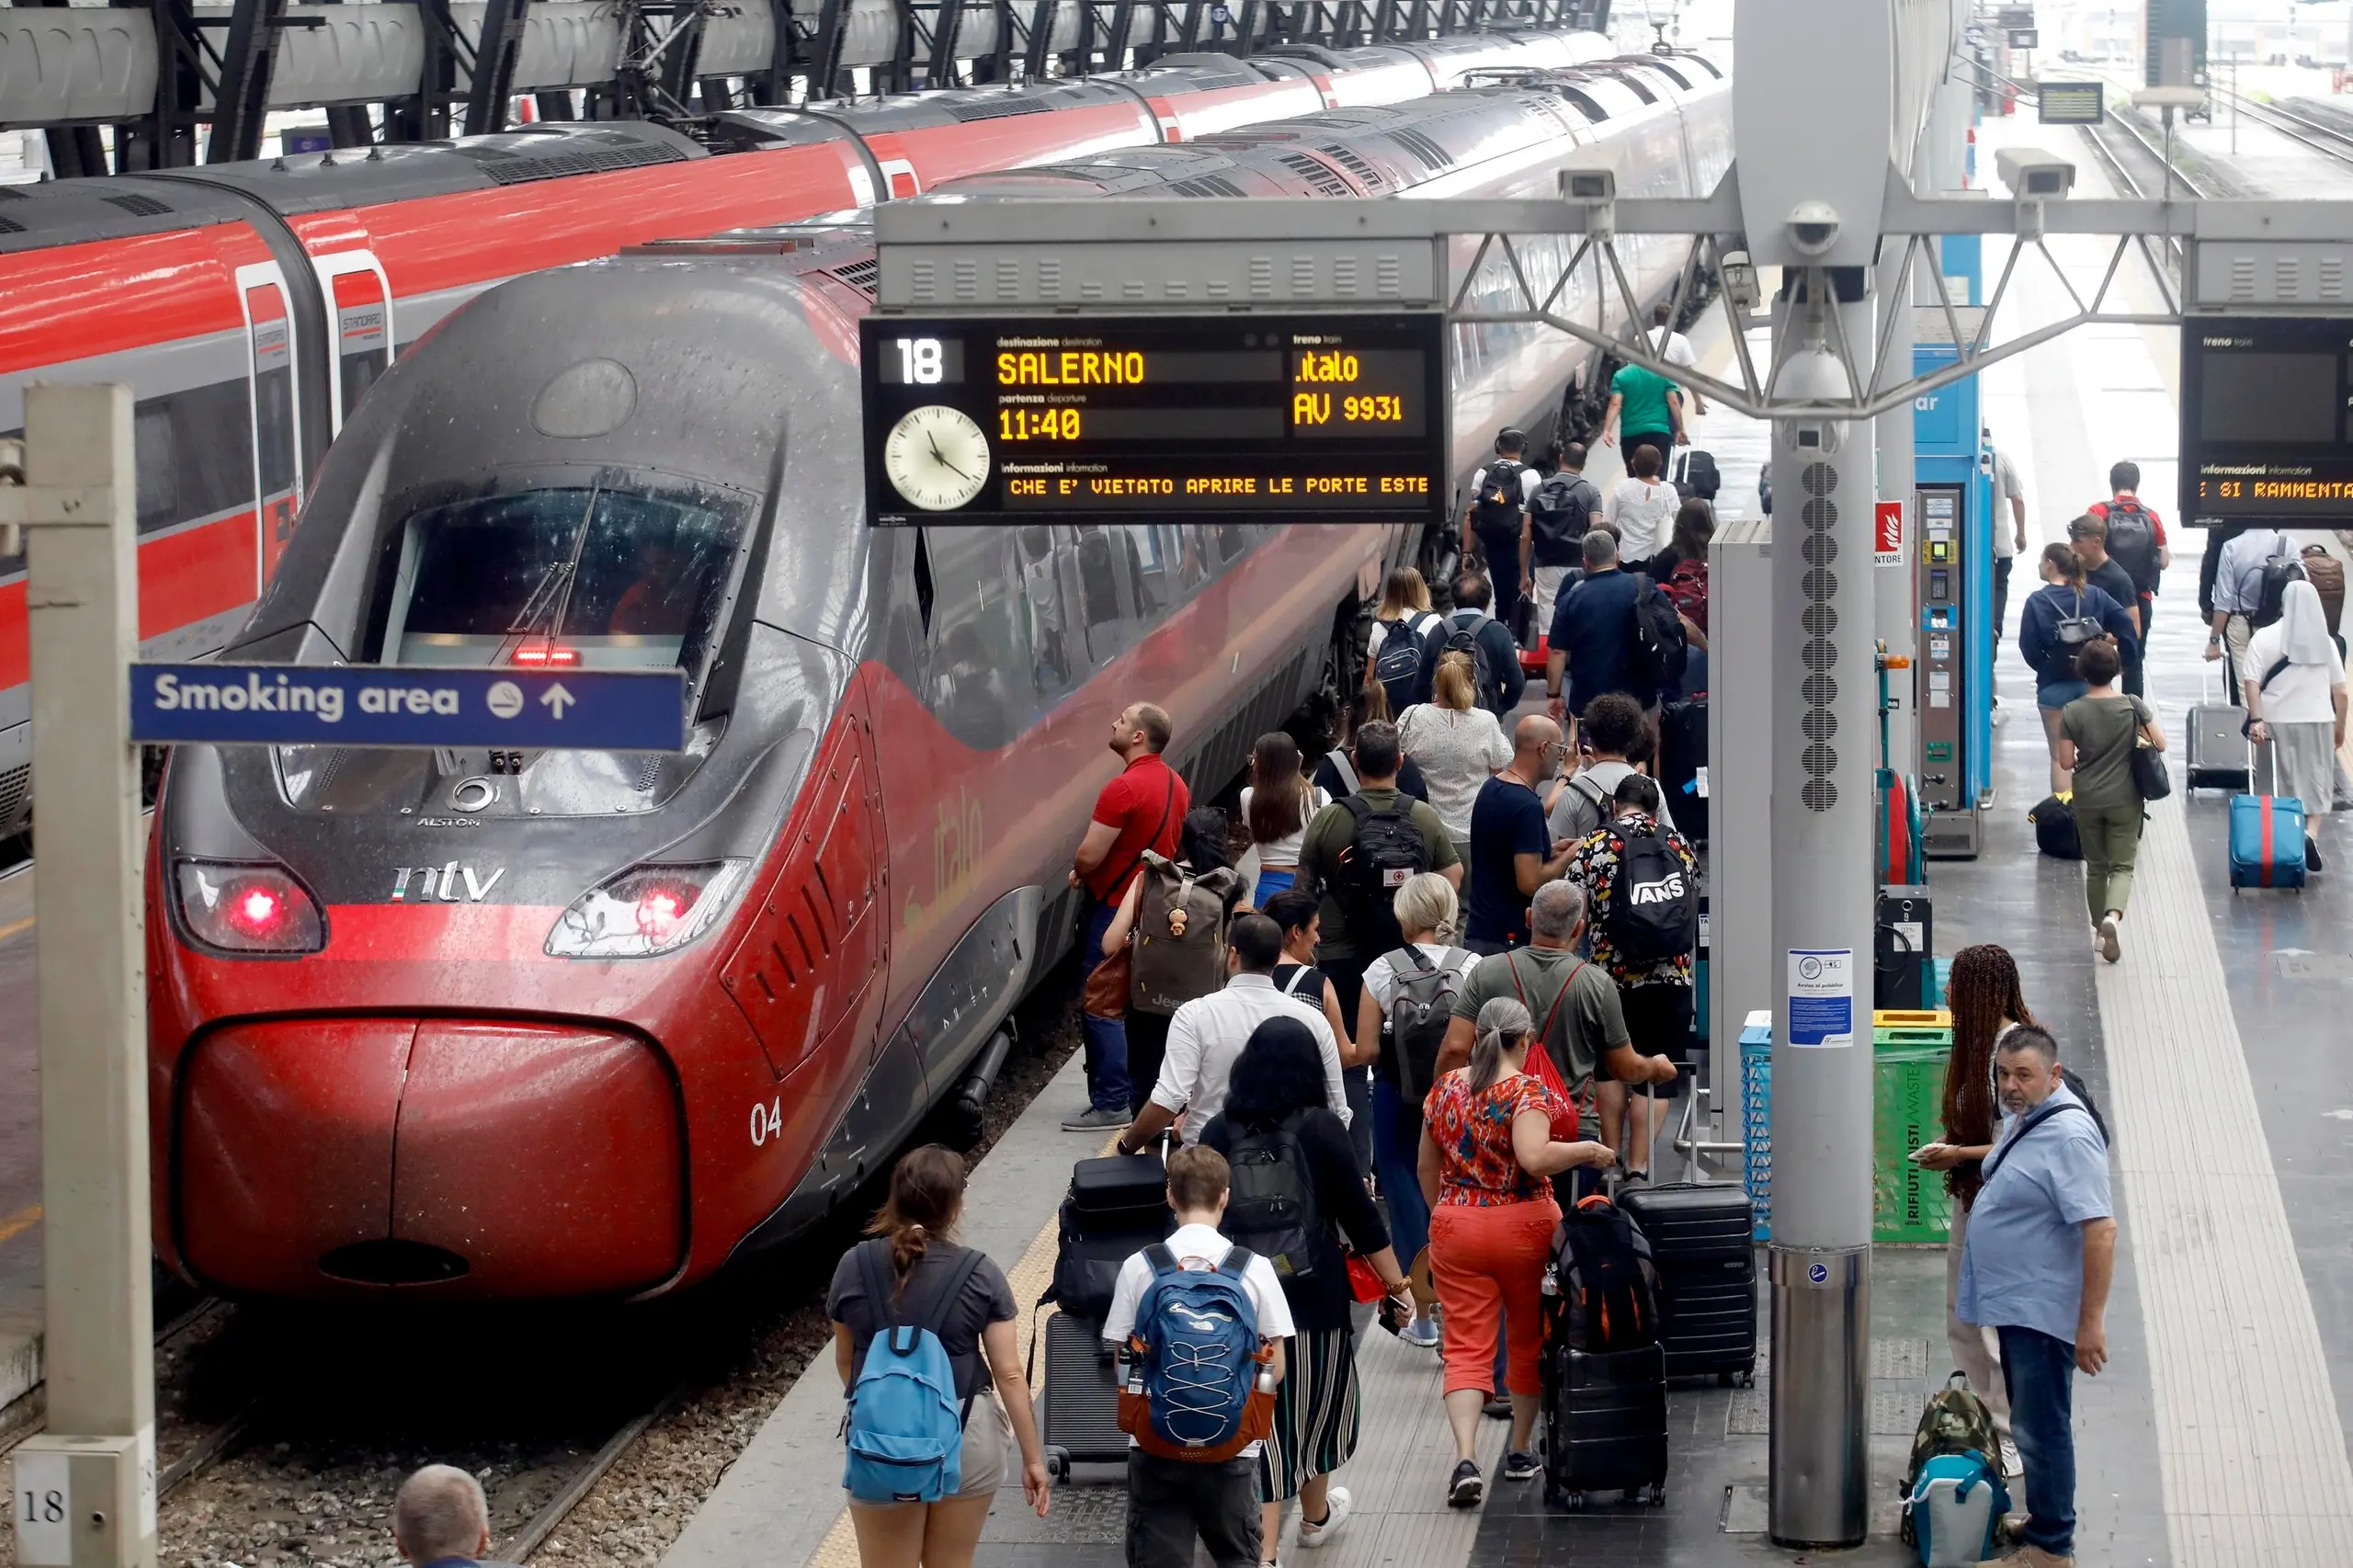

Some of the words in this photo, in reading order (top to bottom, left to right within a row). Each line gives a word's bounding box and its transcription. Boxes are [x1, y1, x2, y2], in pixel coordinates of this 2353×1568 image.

[343, 312, 381, 330] STANDARD
[996, 336, 1060, 347] destinazione
[1062, 337, 1102, 347] destination
[1293, 335, 1322, 345] treno
[1324, 335, 1342, 344] train
[2203, 335, 2232, 347] treno
[2234, 337, 2254, 347] train
[897, 338, 942, 383] 18
[997, 352, 1144, 384] SALERNO
[998, 393, 1045, 405] partenza
[1047, 392, 1086, 404] departure
[1294, 393, 1331, 425] AV
[1344, 396, 1402, 421] 9931
[1000, 409, 1080, 439] 11:40
[1001, 462, 1063, 473] informazioni
[1066, 463, 1108, 473] information
[2200, 462, 2267, 475] informazioni
[2268, 464, 2313, 475] information
[1011, 479, 1047, 494] CHE
[1060, 479, 1078, 494] E'
[1091, 479, 1173, 494] VIETATO
[1187, 478, 1256, 494] APRIRE
[1269, 478, 1293, 494] LE
[1306, 477, 1368, 494] PORTE
[1381, 477, 1428, 493] ESTE
[154, 672, 344, 722] Smoking
[358, 687, 460, 714] area
[417, 817, 481, 827] ALSTOM
[392, 860, 506, 902] ntv
[1630, 872, 1684, 905] VANS
[751, 1095, 782, 1146] 04
[1908, 1168, 1919, 1219] RIFIUTI
[24, 1490, 64, 1523] 18
